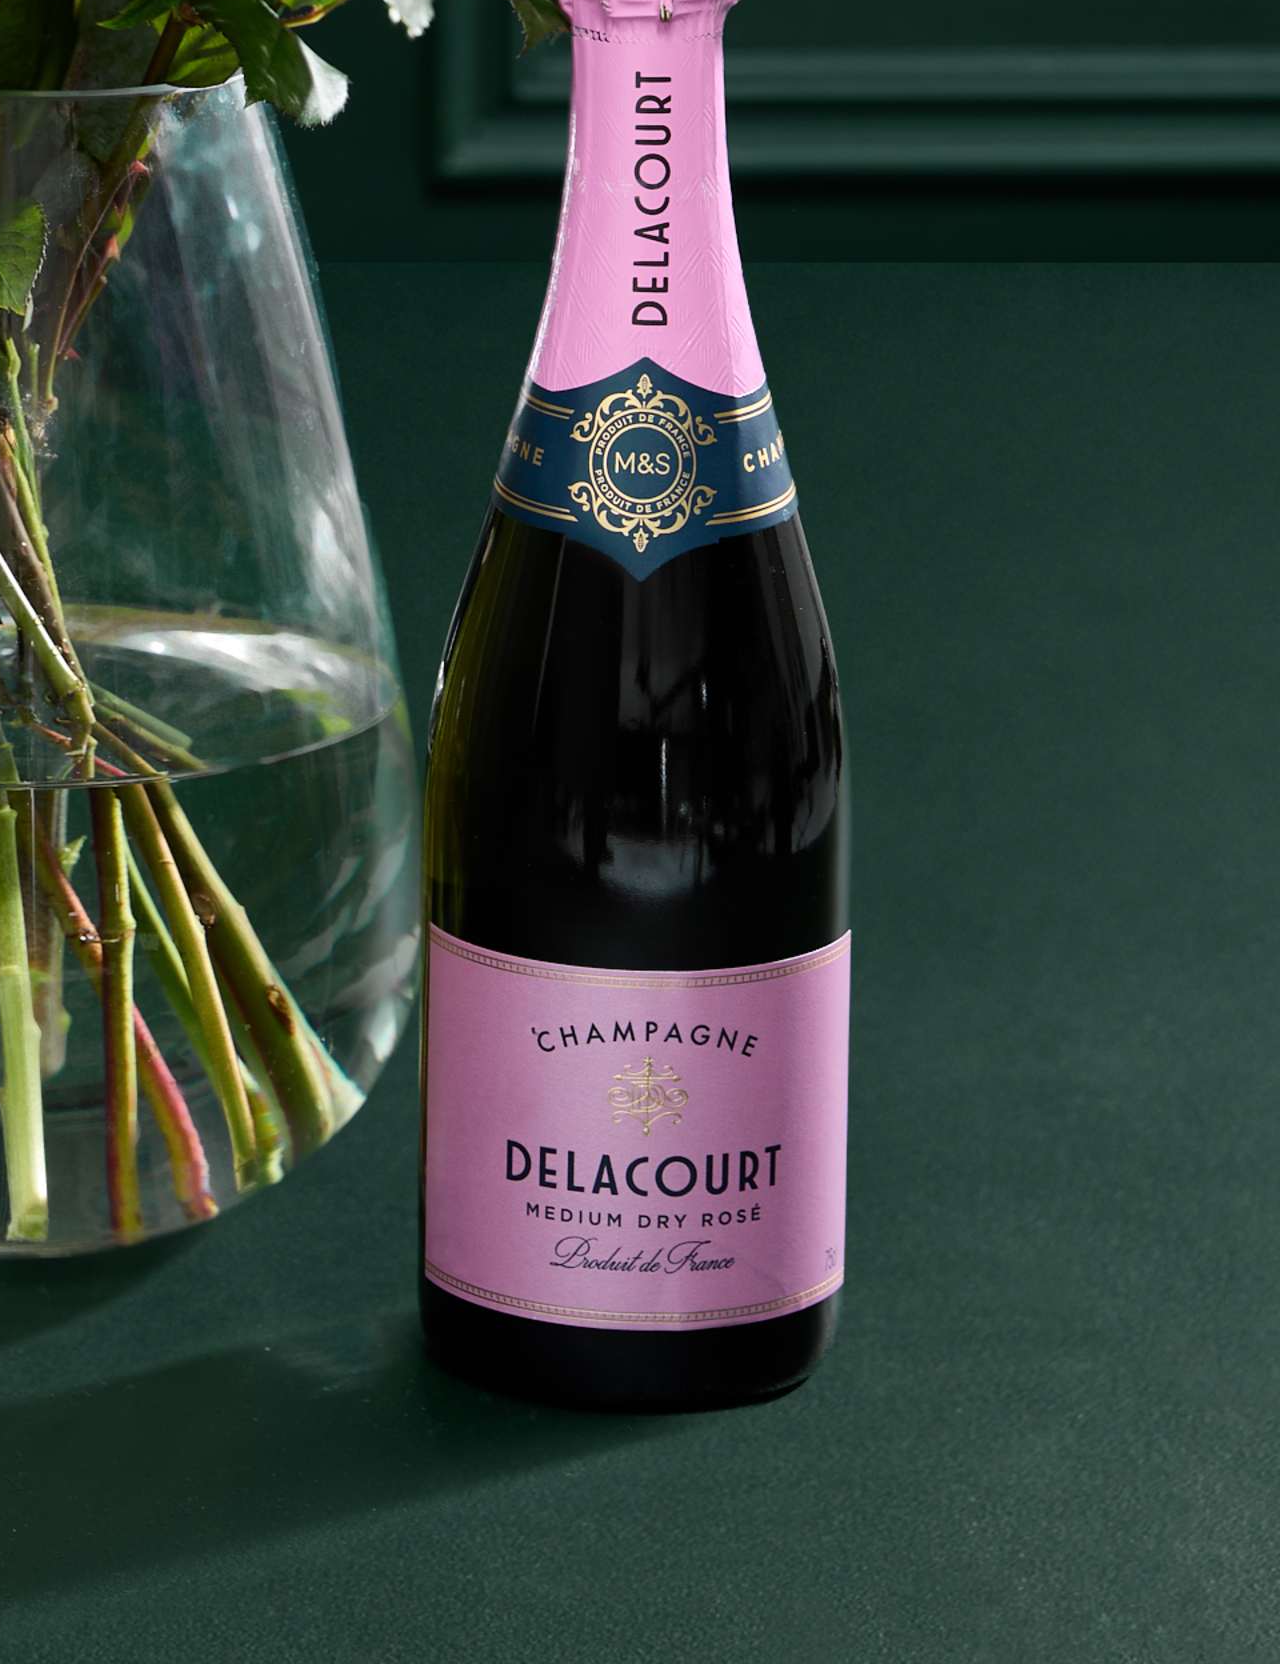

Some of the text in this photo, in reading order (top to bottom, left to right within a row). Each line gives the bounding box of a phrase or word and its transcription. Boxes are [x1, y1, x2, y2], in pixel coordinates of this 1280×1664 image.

[632, 71, 671, 325] DELACOURT
[595, 414, 691, 458] PRODUIT DE FRANCE
[614, 451, 671, 475] M&S
[594, 469, 690, 513] PRODUIT DE FRANCE
[506, 1140, 781, 1197] DELACOURT
[526, 1202, 761, 1229] MEDIUM DRY ROSÉ
[549, 1236, 735, 1274] Produit de France
